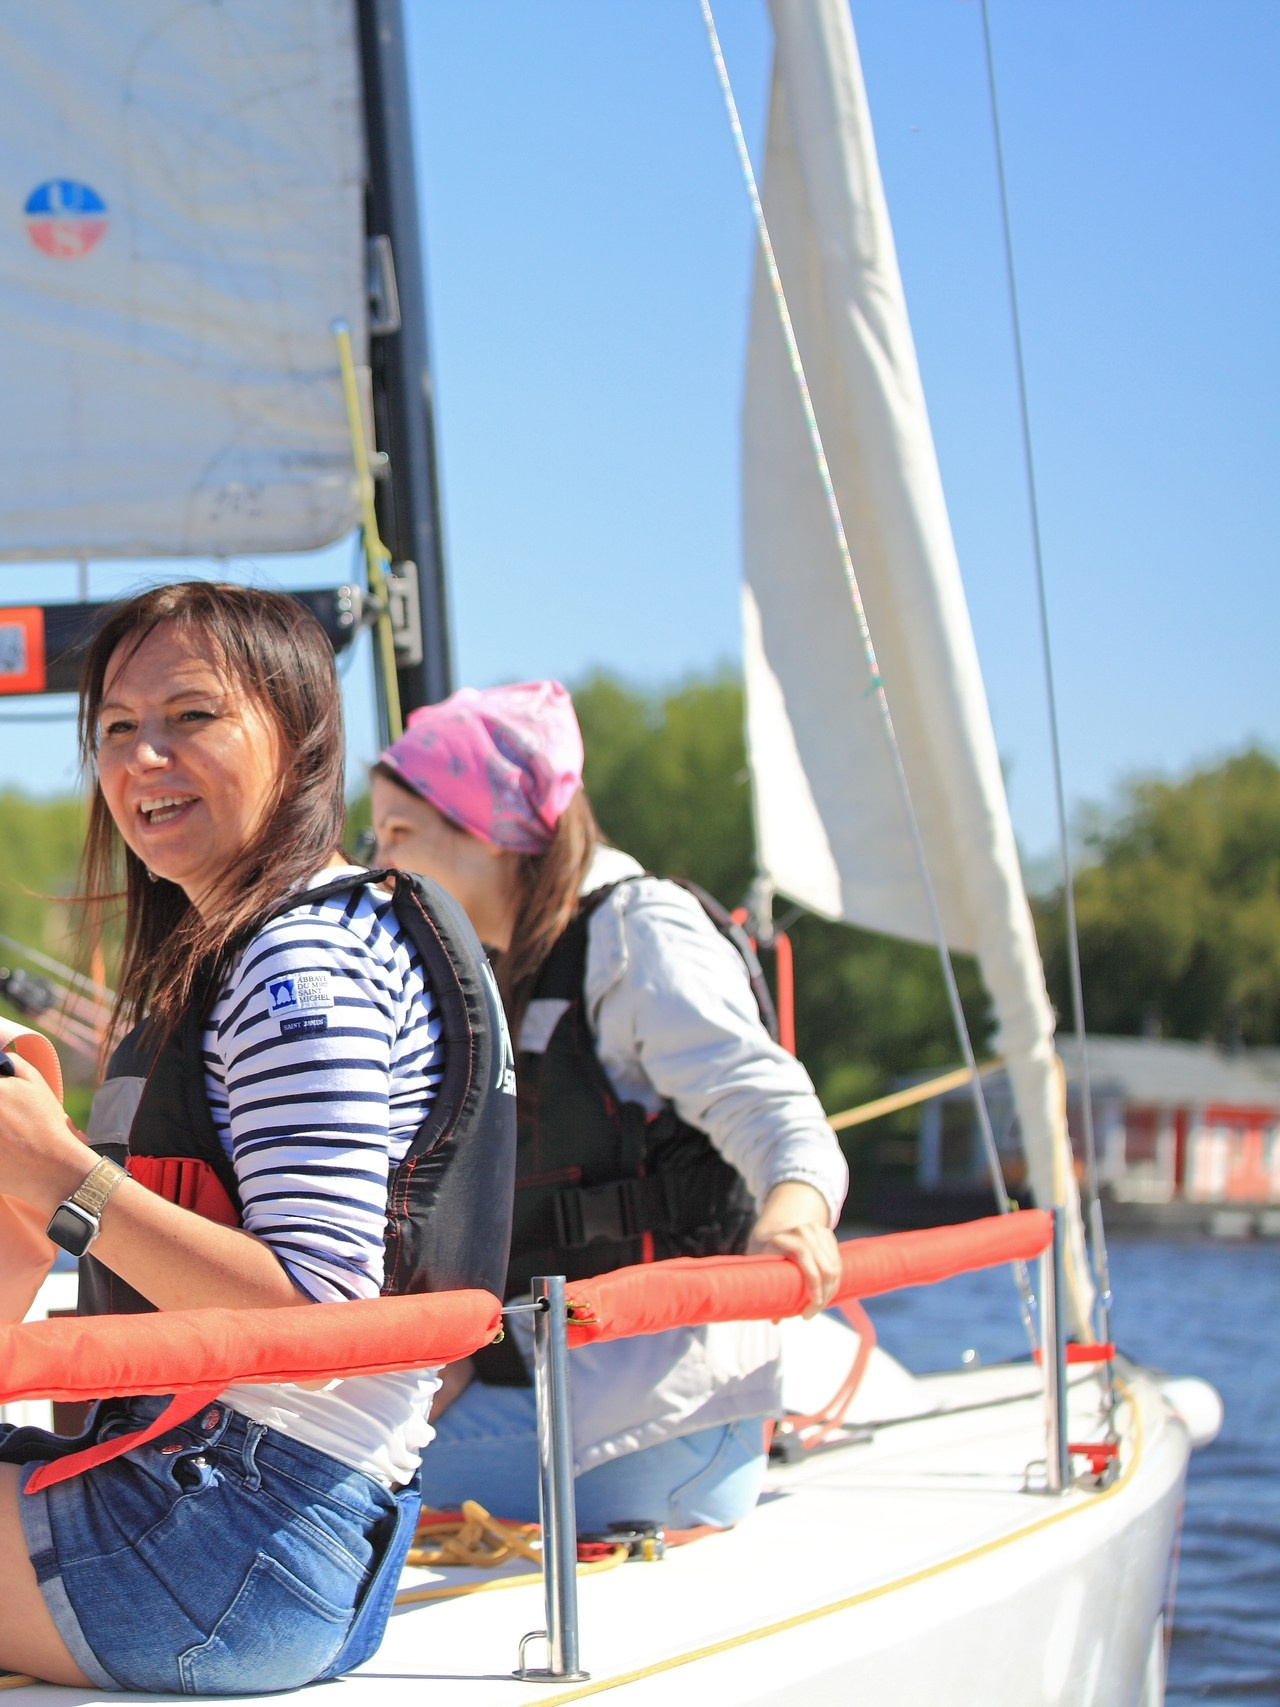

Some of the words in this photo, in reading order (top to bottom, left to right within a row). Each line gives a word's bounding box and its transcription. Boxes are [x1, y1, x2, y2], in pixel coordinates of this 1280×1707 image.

[298, 988, 322, 996] SAINT
[299, 995, 330, 1003] MICHEL
[284, 1022, 301, 1030] SAINT
